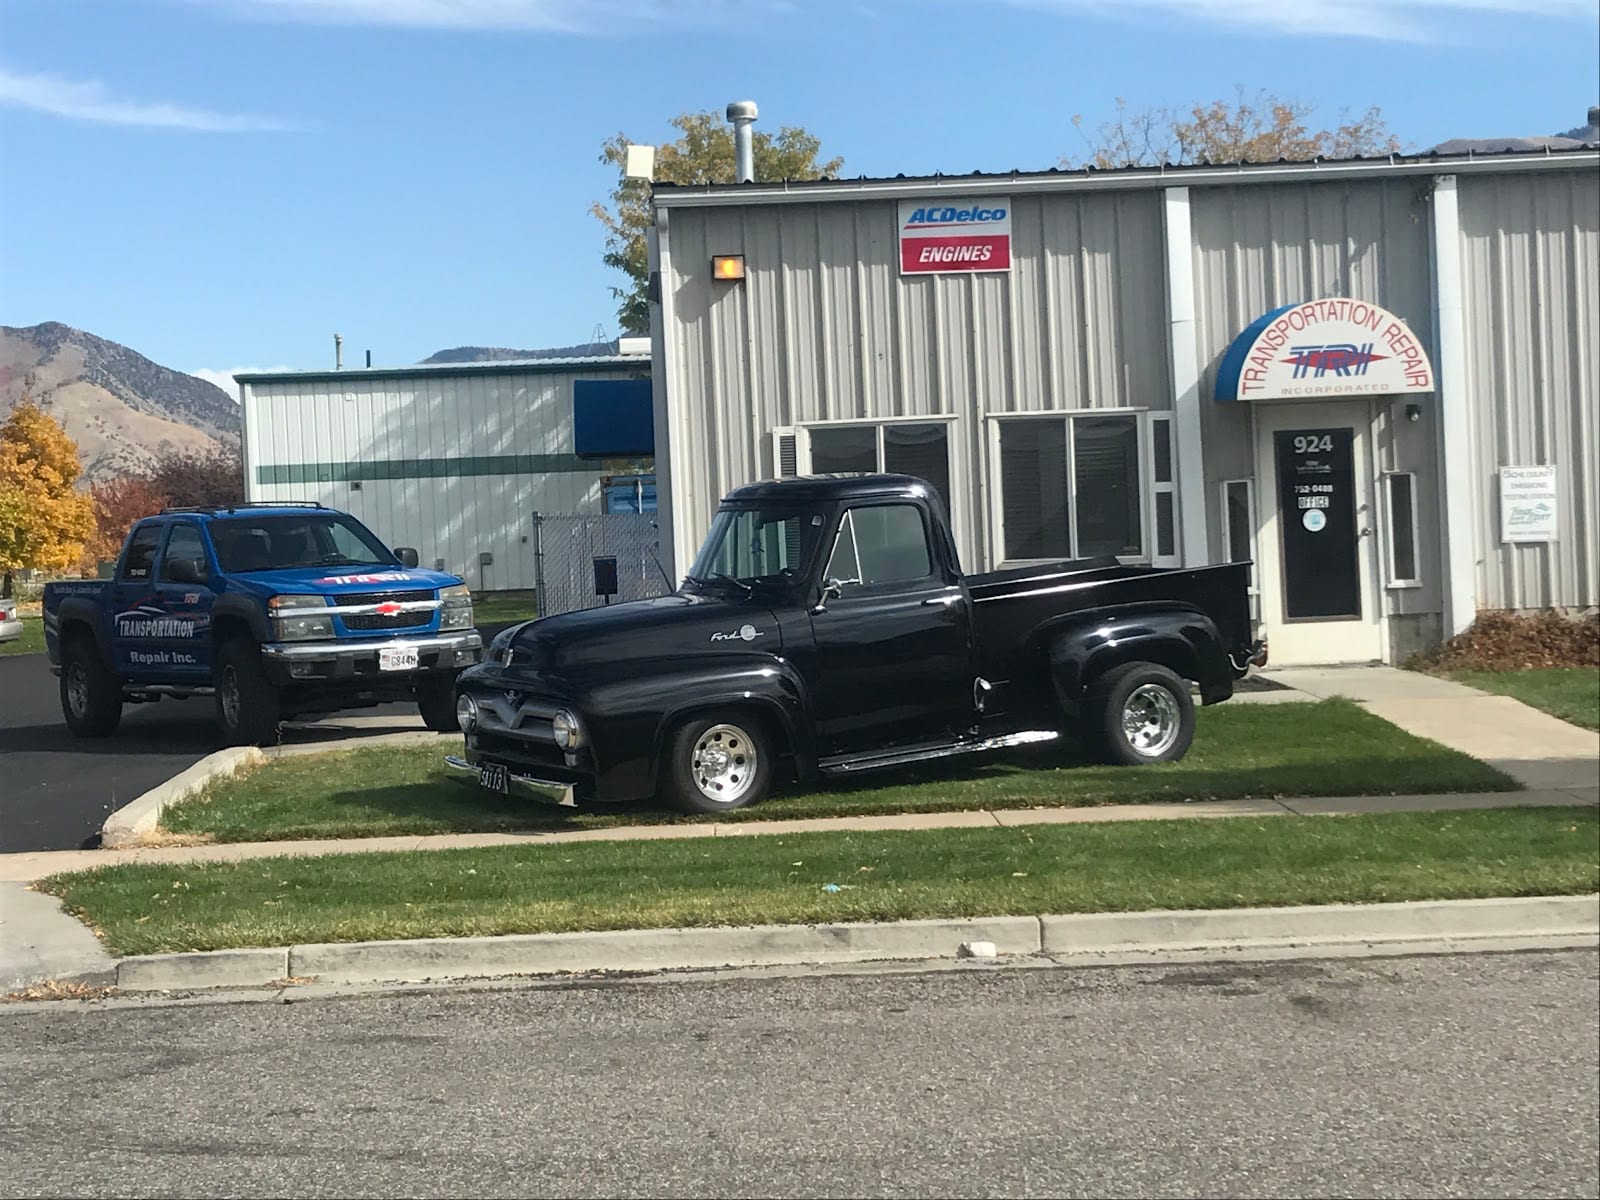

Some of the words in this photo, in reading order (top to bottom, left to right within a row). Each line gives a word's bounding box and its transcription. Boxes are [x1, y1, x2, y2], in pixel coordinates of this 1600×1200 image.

[908, 205, 1007, 223] ACDelco
[919, 245, 992, 263] ENGINES
[1242, 300, 1384, 395] TRANSPORTATION
[1381, 323, 1429, 388] REPAIR
[1281, 384, 1389, 395] INCORPORATED
[1293, 434, 1333, 453] 924
[1299, 497, 1328, 508] OFFICE
[119, 620, 195, 638] TRANSPORTATION
[710, 630, 738, 642] Ford
[130, 651, 170, 664] Repair
[172, 652, 197, 664] Inc.
